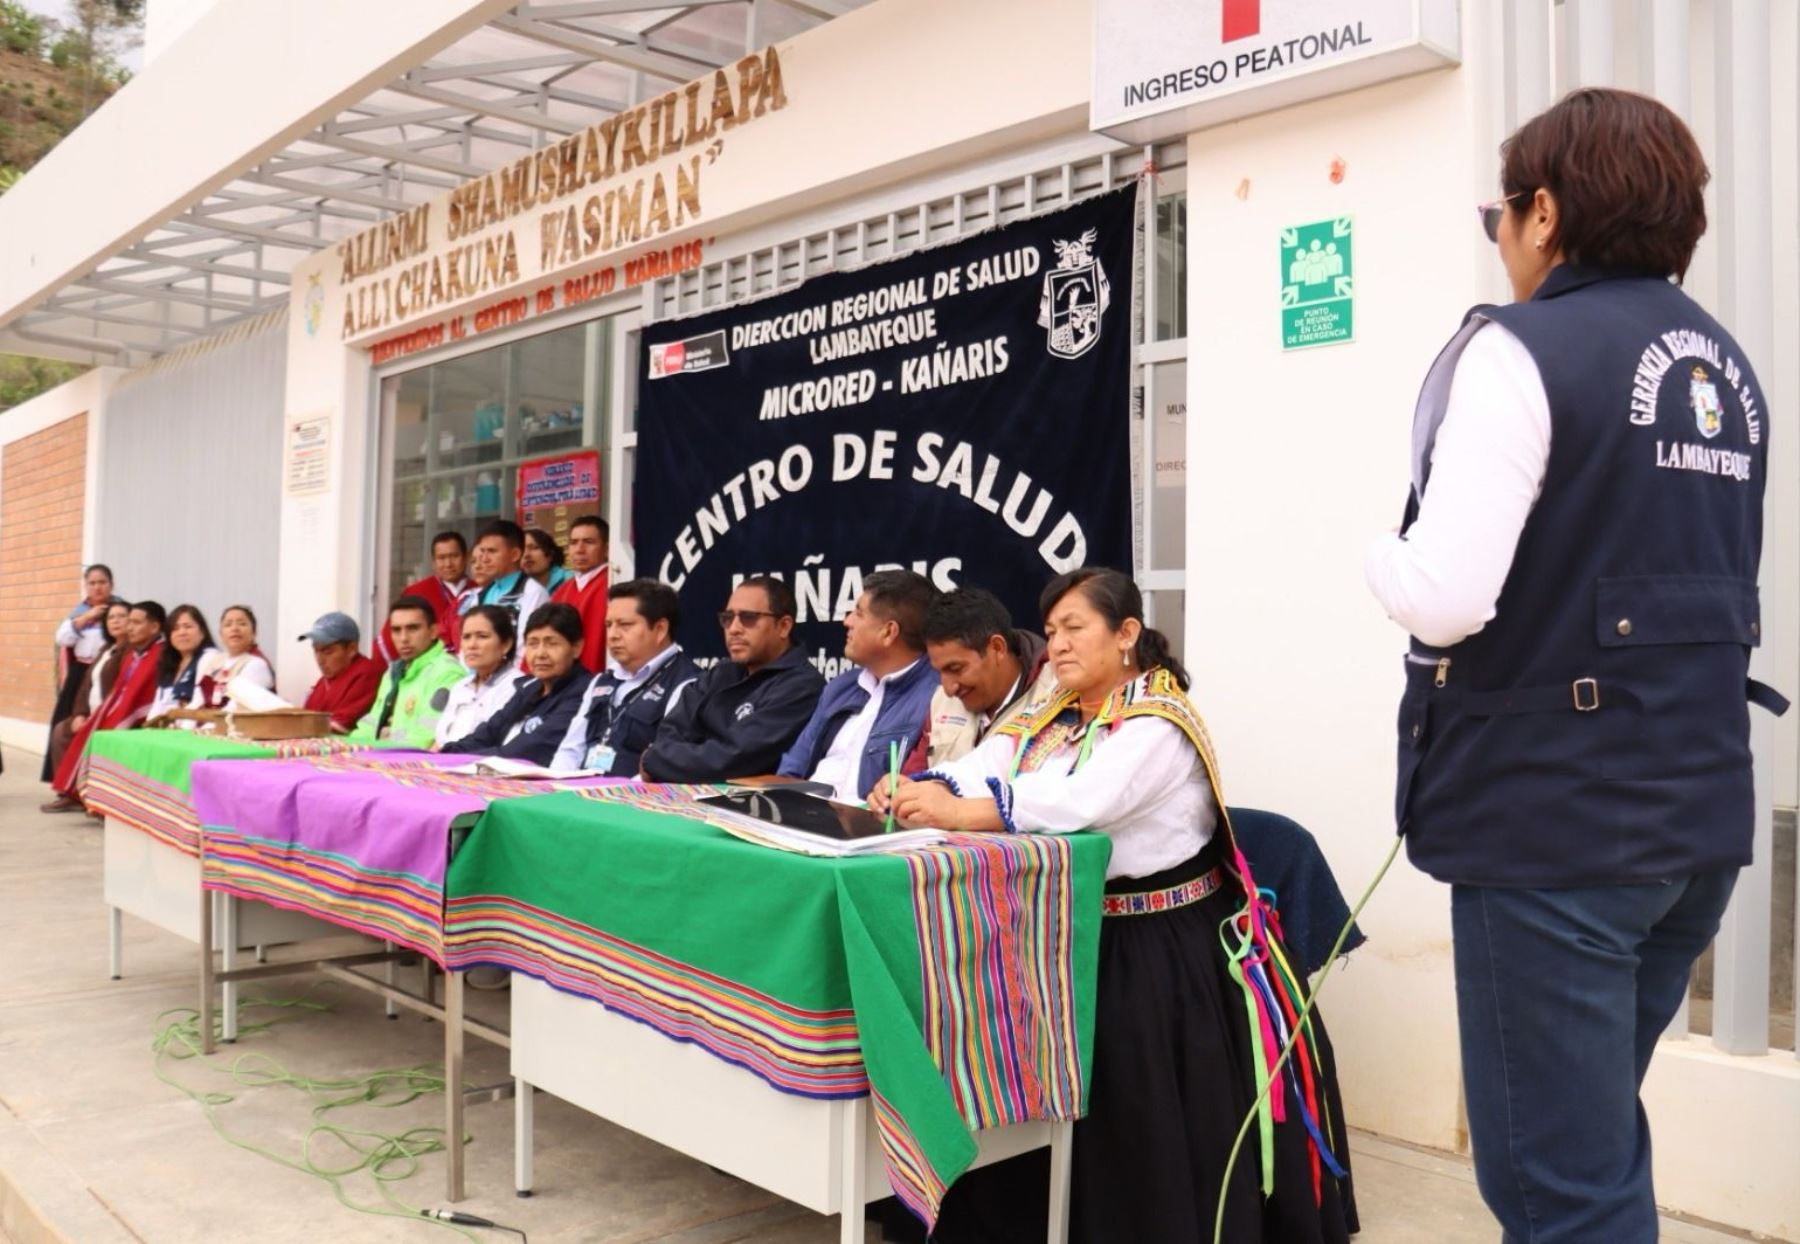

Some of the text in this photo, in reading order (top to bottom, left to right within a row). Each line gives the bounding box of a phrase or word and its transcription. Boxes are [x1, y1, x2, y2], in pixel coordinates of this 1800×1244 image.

[1123, 21, 1372, 107] INGRESO PEATONAL
[450, 316, 466, 341] AL
[474, 296, 528, 334] CENTRO
[536, 285, 555, 315] DE
[563, 267, 617, 306] SALUD
[731, 245, 1041, 351] DIERCCION REGIONAL DE SALUD
[1295, 319, 1304, 328] DE
[1301, 322, 1333, 334] EN CASO
[1304, 307, 1329, 317] PUNTO
[809, 308, 937, 365] LAMBAYEQUE
[1287, 328, 1347, 344] DE EMERGENCIA
[759, 368, 877, 421] MICRORED
[900, 336, 1010, 395] KAÑARIS
[1629, 329, 1761, 445] GERENCIA REGIONAL DE SALUD
[1655, 440, 1752, 481] LAMBAYEQUE
[658, 444, 813, 593] CENTRO
[832, 430, 898, 482] DE
[912, 432, 1087, 575] SALUD
